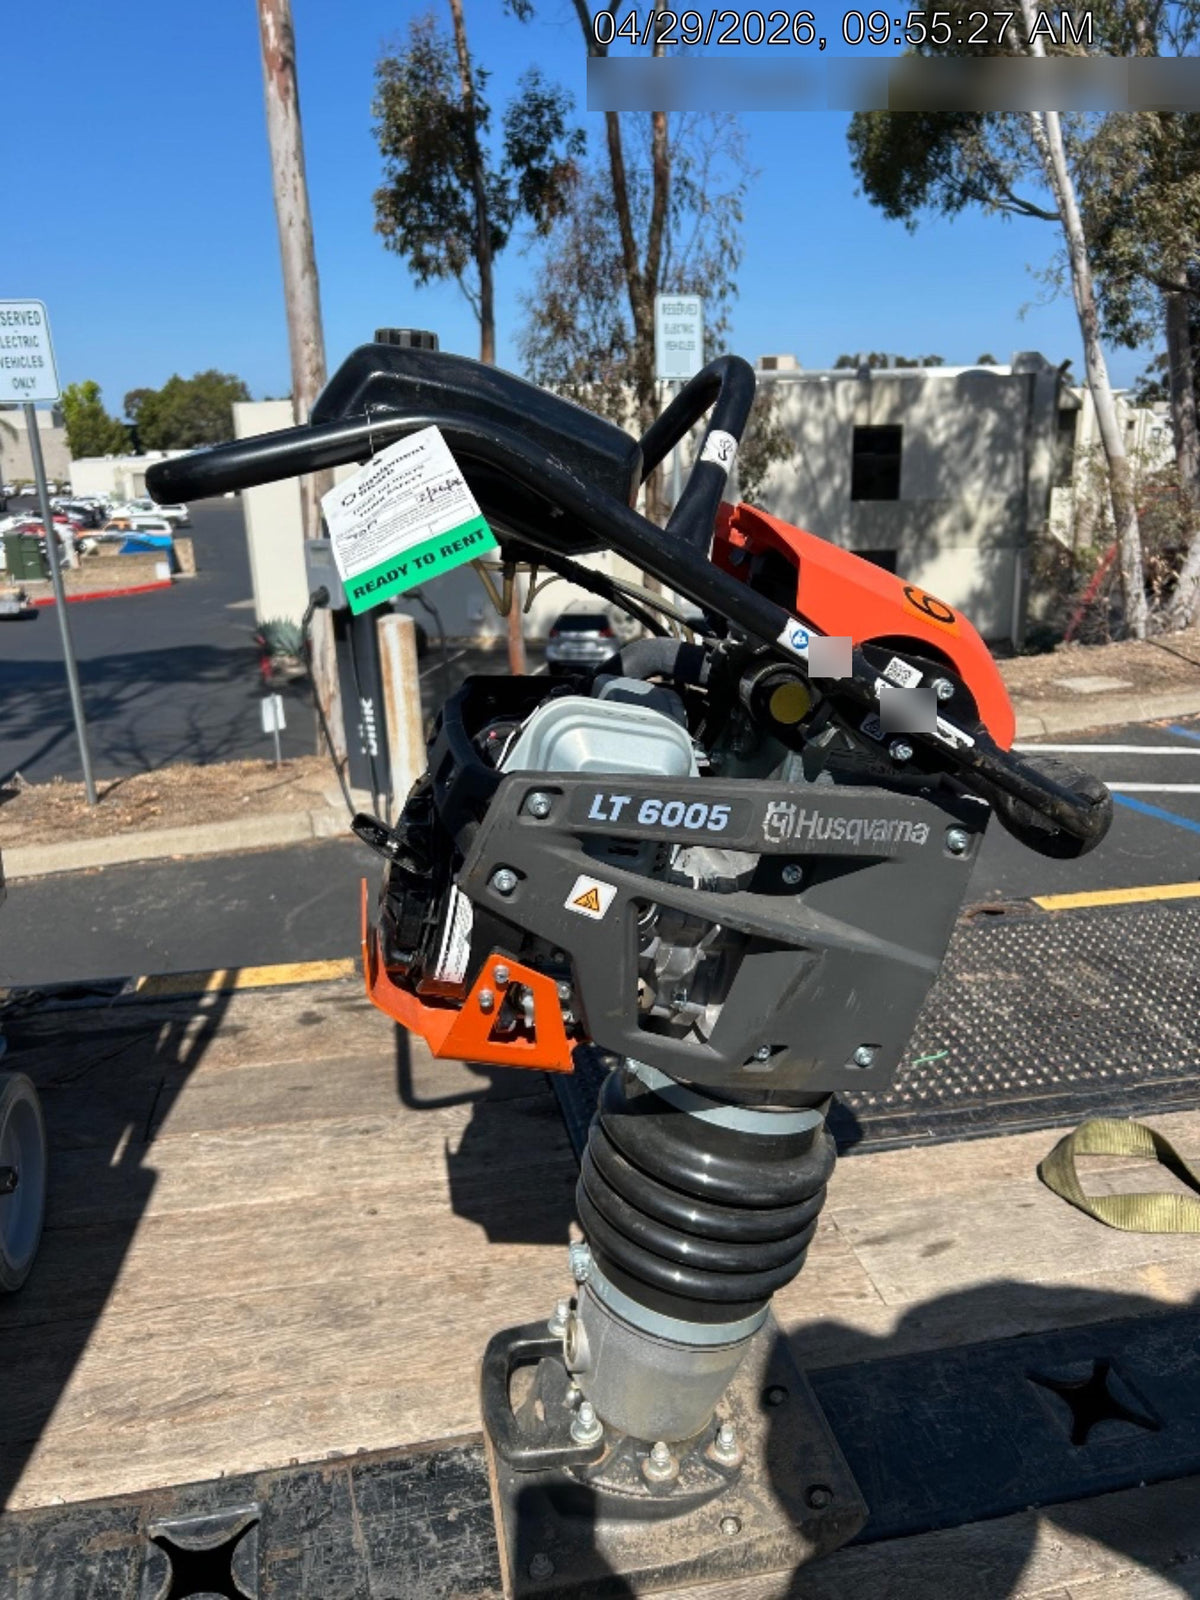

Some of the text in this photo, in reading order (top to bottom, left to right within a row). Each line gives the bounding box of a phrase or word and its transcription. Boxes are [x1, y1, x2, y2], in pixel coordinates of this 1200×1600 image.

[12, 376, 36, 390] ONLY
[352, 528, 485, 599] READY TO RENT
[587, 793, 732, 831] LT 6005
[794, 808, 931, 846] Husqvarna
